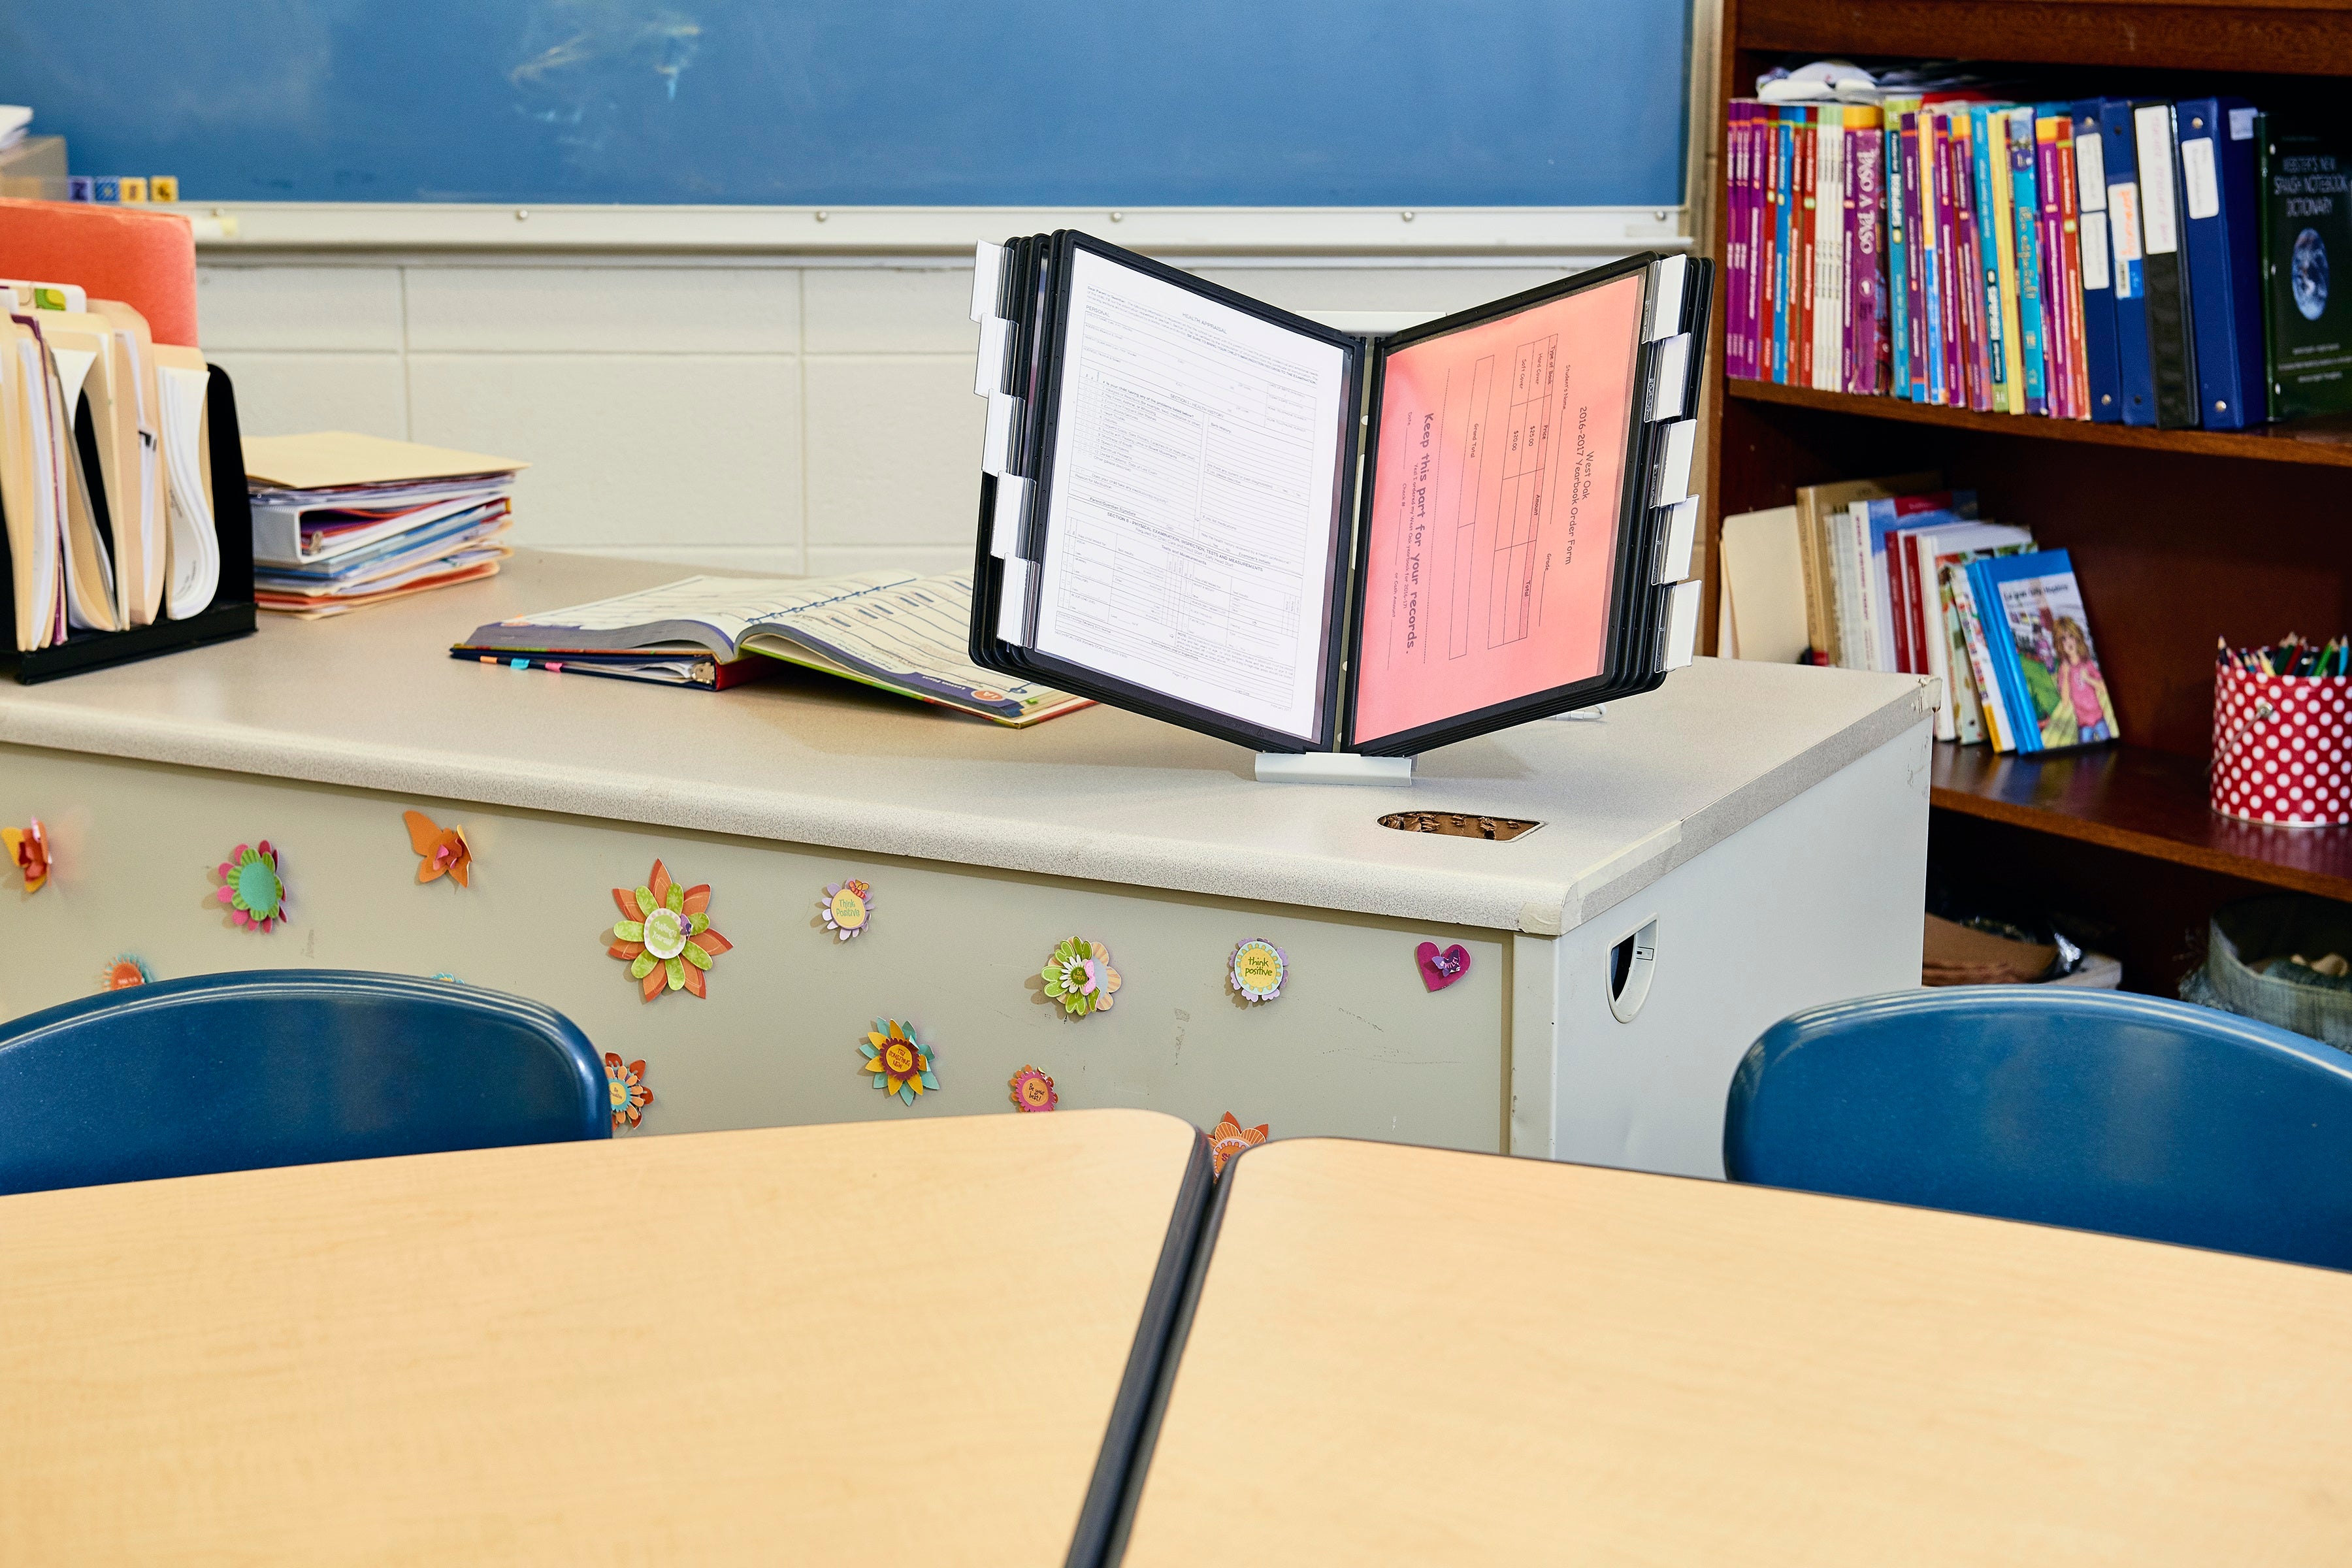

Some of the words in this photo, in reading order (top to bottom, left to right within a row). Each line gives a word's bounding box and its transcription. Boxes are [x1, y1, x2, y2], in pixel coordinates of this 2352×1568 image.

[1857, 148, 1877, 192] PASO
[1858, 210, 1877, 255] PASO
[1086, 304, 1109, 317] PERSONAL
[1183, 312, 1200, 323] HEALTH
[1201, 320, 1226, 333] APPRAISAL
[1170, 393, 1187, 404] SECTION
[1192, 402, 1206, 412] HEALTH
[1207, 408, 1223, 418] HISTORY
[1419, 412, 1433, 449] Keep
[1575, 405, 1587, 458] 2016-2017
[1418, 452, 1431, 482] this
[1583, 451, 1594, 478] West
[1571, 459, 1582, 505] Yearbook
[1581, 479, 1592, 500] Oak
[1413, 486, 1428, 520] part
[1567, 506, 1578, 538] Order
[1107, 512, 1125, 522] SECTION
[1131, 520, 1151, 532] PHYSICAL
[1151, 528, 1180, 544] EXAMINATION,
[1181, 539, 1206, 553] INSPECTION,
[1207, 549, 1219, 557] TESTS
[1230, 557, 1262, 572] MEASUREMENTS
[1413, 523, 1426, 549] for
[1564, 539, 1574, 565] Form
[1408, 552, 1421, 587] your
[1405, 590, 1420, 654] records.
[836, 907, 860, 917] Positive
[840, 899, 855, 909] Think
[1245, 966, 1273, 977] positive
[1248, 957, 1269, 967] think
[1028, 1092, 1041, 1102] best!
